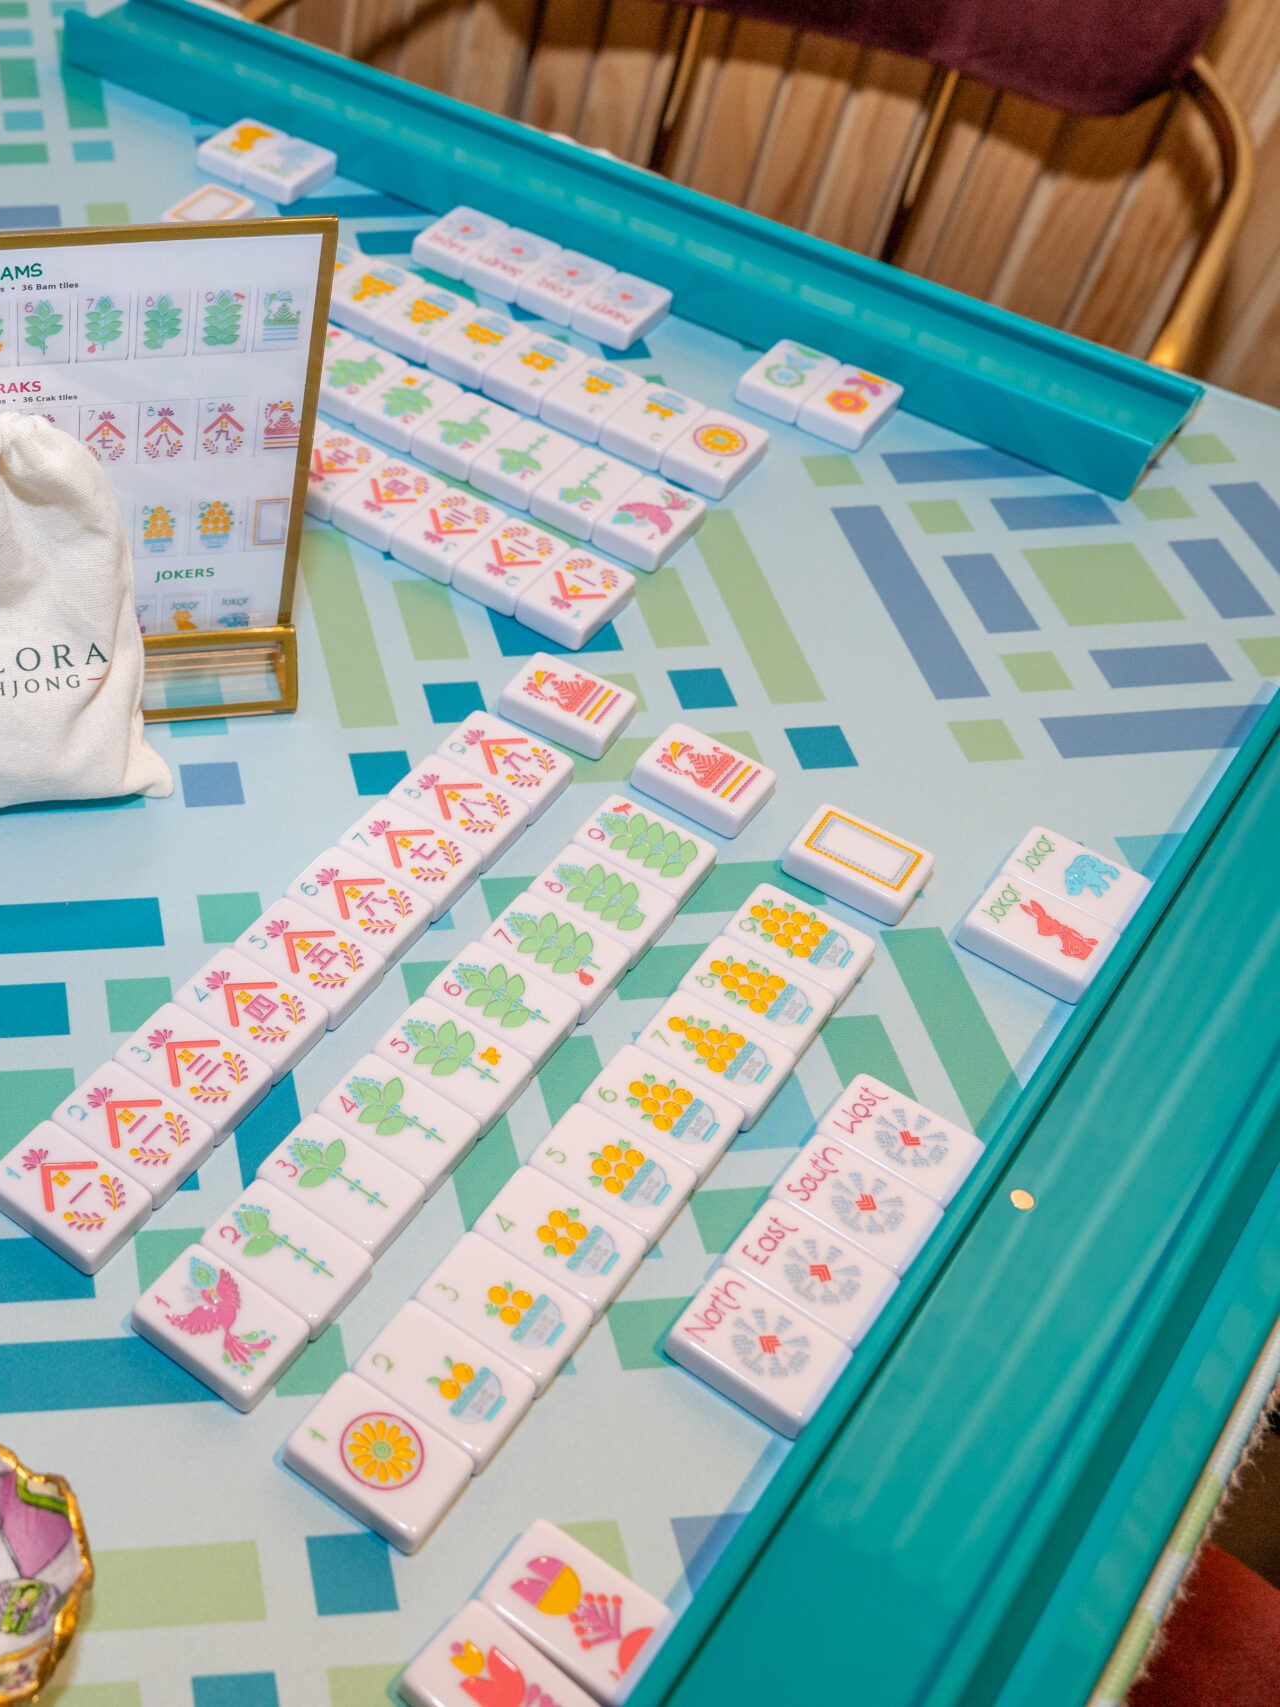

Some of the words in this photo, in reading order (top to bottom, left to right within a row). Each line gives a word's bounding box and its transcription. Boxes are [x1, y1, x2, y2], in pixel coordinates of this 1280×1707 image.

[36, 283, 57, 291] Bam
[59, 281, 79, 290] tiles
[86, 298, 95, 310] 7
[145, 296, 154, 308] 8
[204, 291, 216, 303] 9
[24, 301, 34, 313] 6
[22, 396, 33, 404] 36
[35, 395, 56, 403] Crak
[59, 393, 78, 402] tiles
[88, 409, 96, 422] 7
[154, 567, 215, 583] JOKERS
[449, 741, 467, 755] 9
[403, 787, 422, 799] 8
[352, 832, 370, 847] 7
[587, 827, 607, 842] 9
[300, 881, 319, 897] 6
[543, 879, 565, 894] 8
[738, 917, 759, 934] 9
[248, 934, 268, 950] 5
[492, 927, 514, 945] 7
[443, 980, 463, 997] 6
[695, 974, 715, 990] 8
[193, 986, 210, 1003] 4
[389, 1037, 411, 1054] 5
[650, 1029, 671, 1047] 7
[130, 1046, 152, 1063] 3
[598, 1086, 619, 1104] 6
[66, 1104, 89, 1122] 2
[339, 1095, 359, 1114] 4
[544, 1147, 567, 1165] 5
[275, 1158, 298, 1178] 3
[786, 1145, 844, 1203] South
[495, 1212, 517, 1233] 4
[219, 1225, 241, 1245] 2
[742, 1216, 800, 1267] East
[434, 1282, 459, 1302] 3
[683, 1279, 747, 1344] North
[371, 1352, 395, 1373] 2
